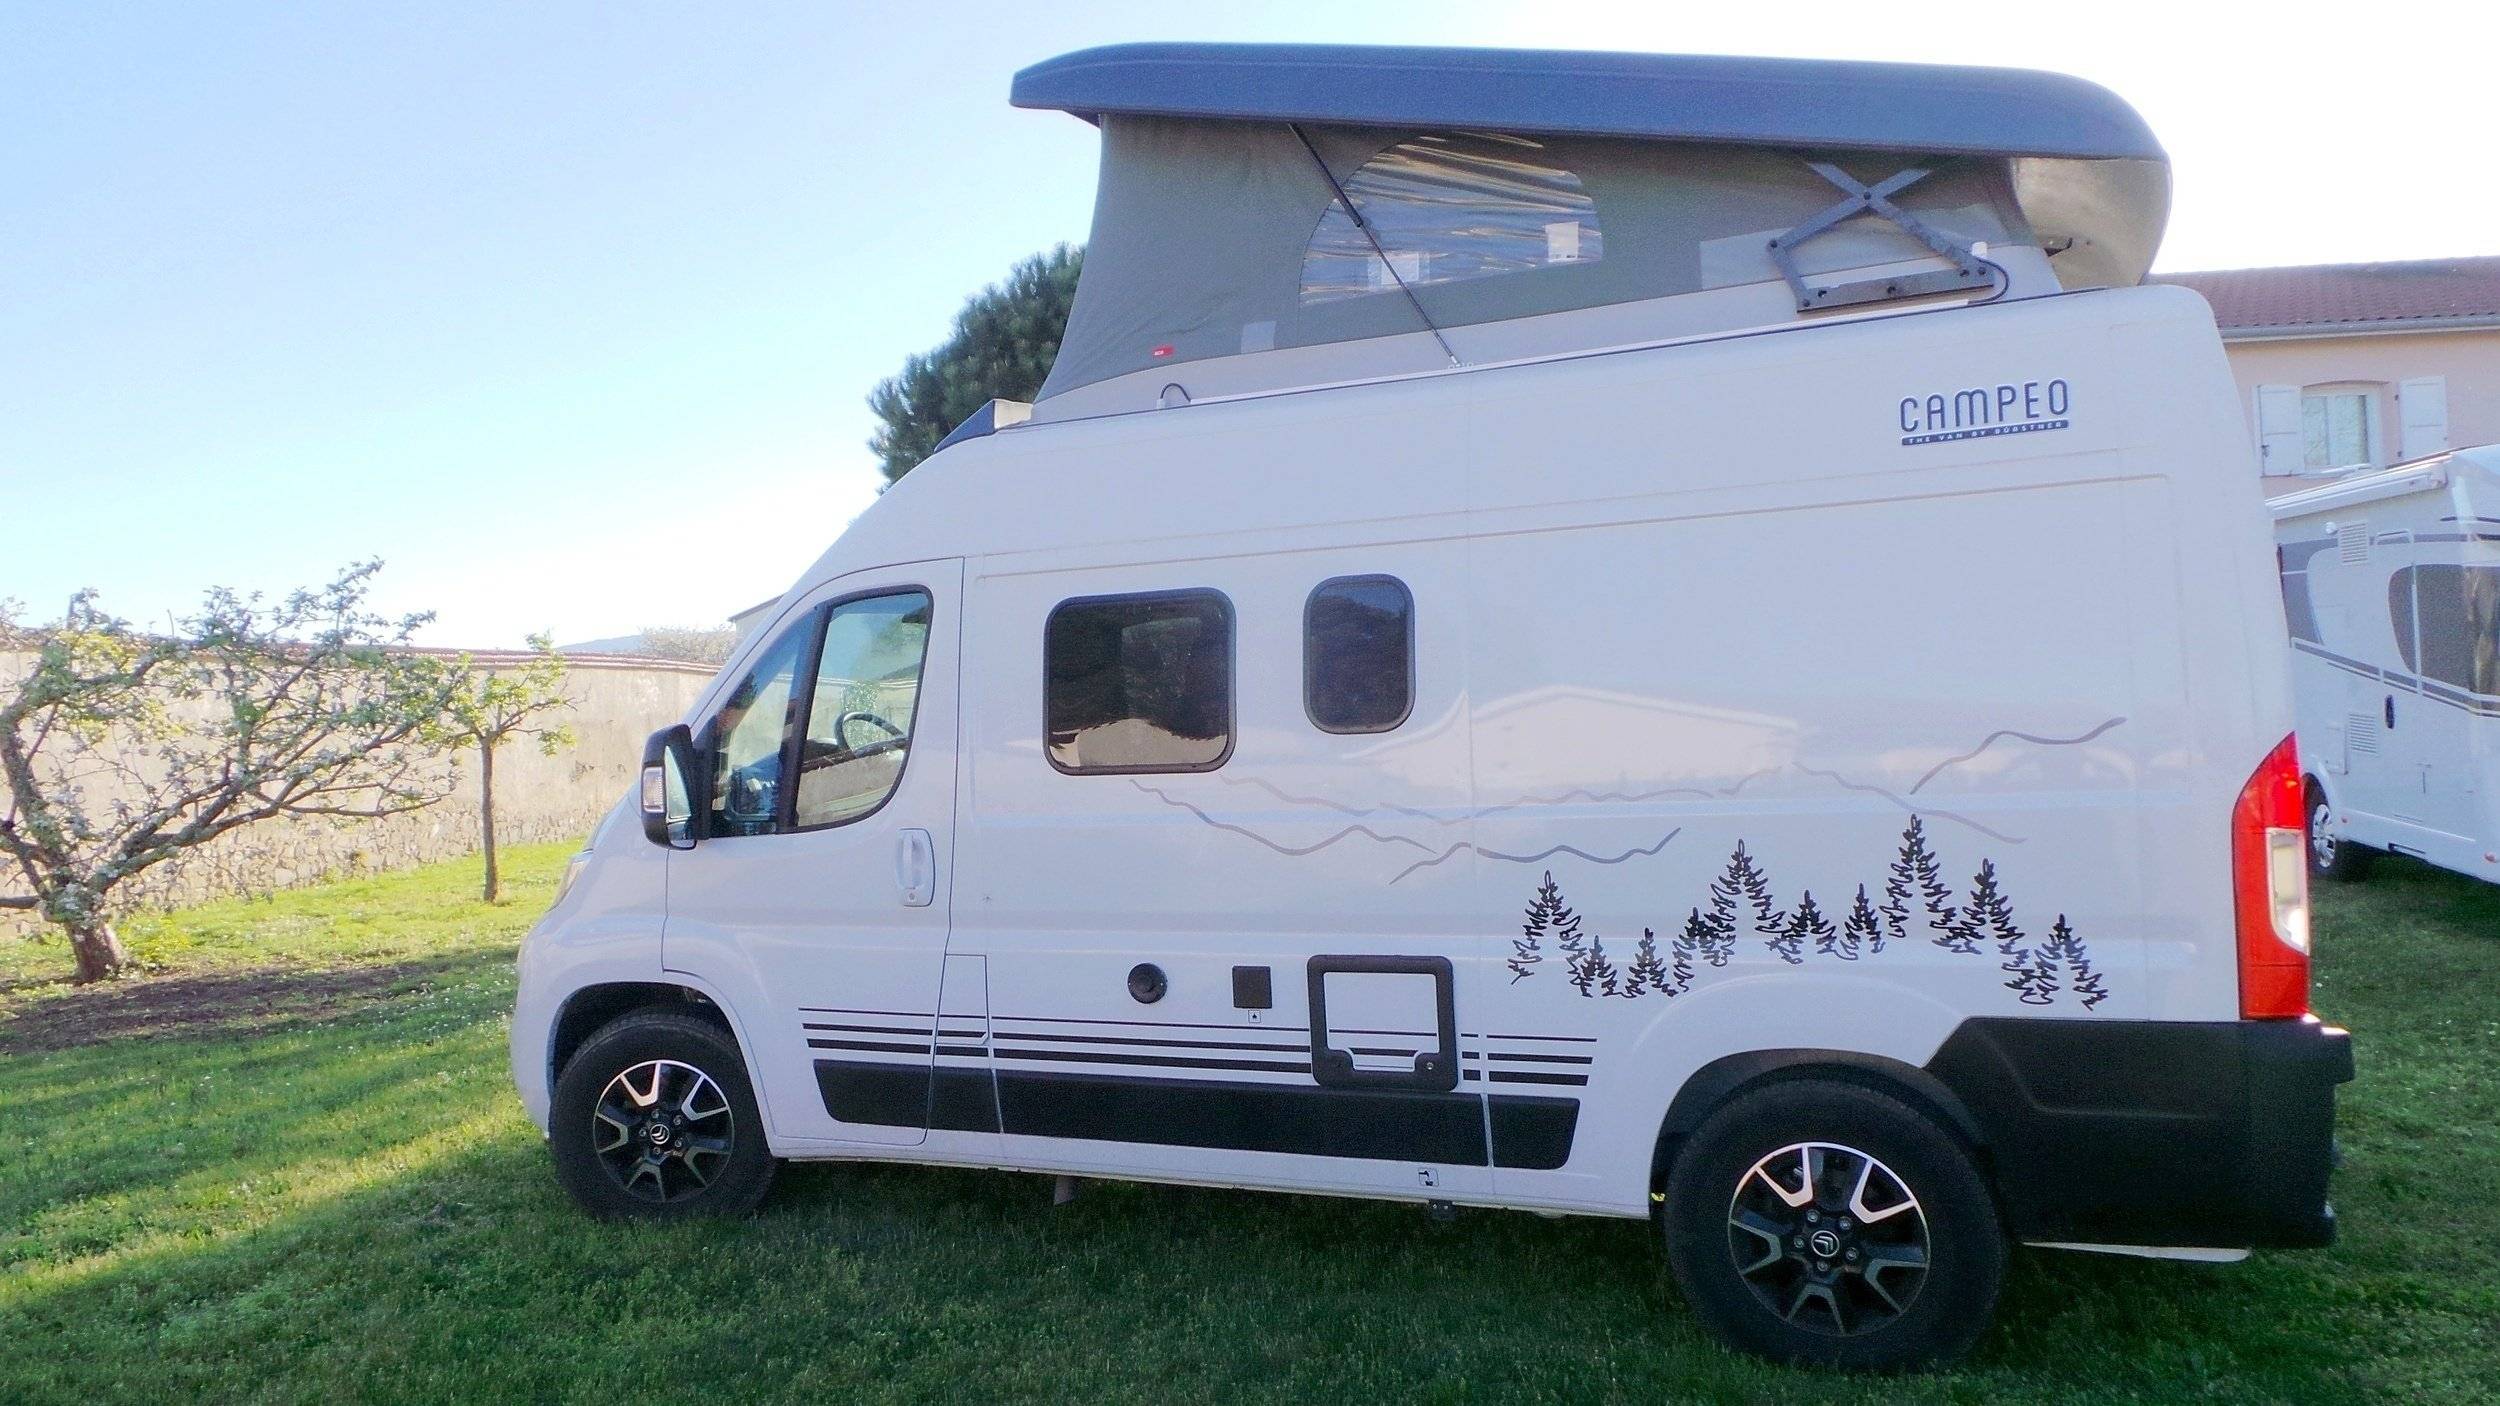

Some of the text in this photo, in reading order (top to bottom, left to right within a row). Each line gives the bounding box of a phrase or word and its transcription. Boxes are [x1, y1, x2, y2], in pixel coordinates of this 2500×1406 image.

[1900, 378, 2069, 432] CAMPEO
[1908, 437, 1931, 445] THE
[1938, 433, 1963, 441] VAN
[1971, 430, 1986, 438] BY
